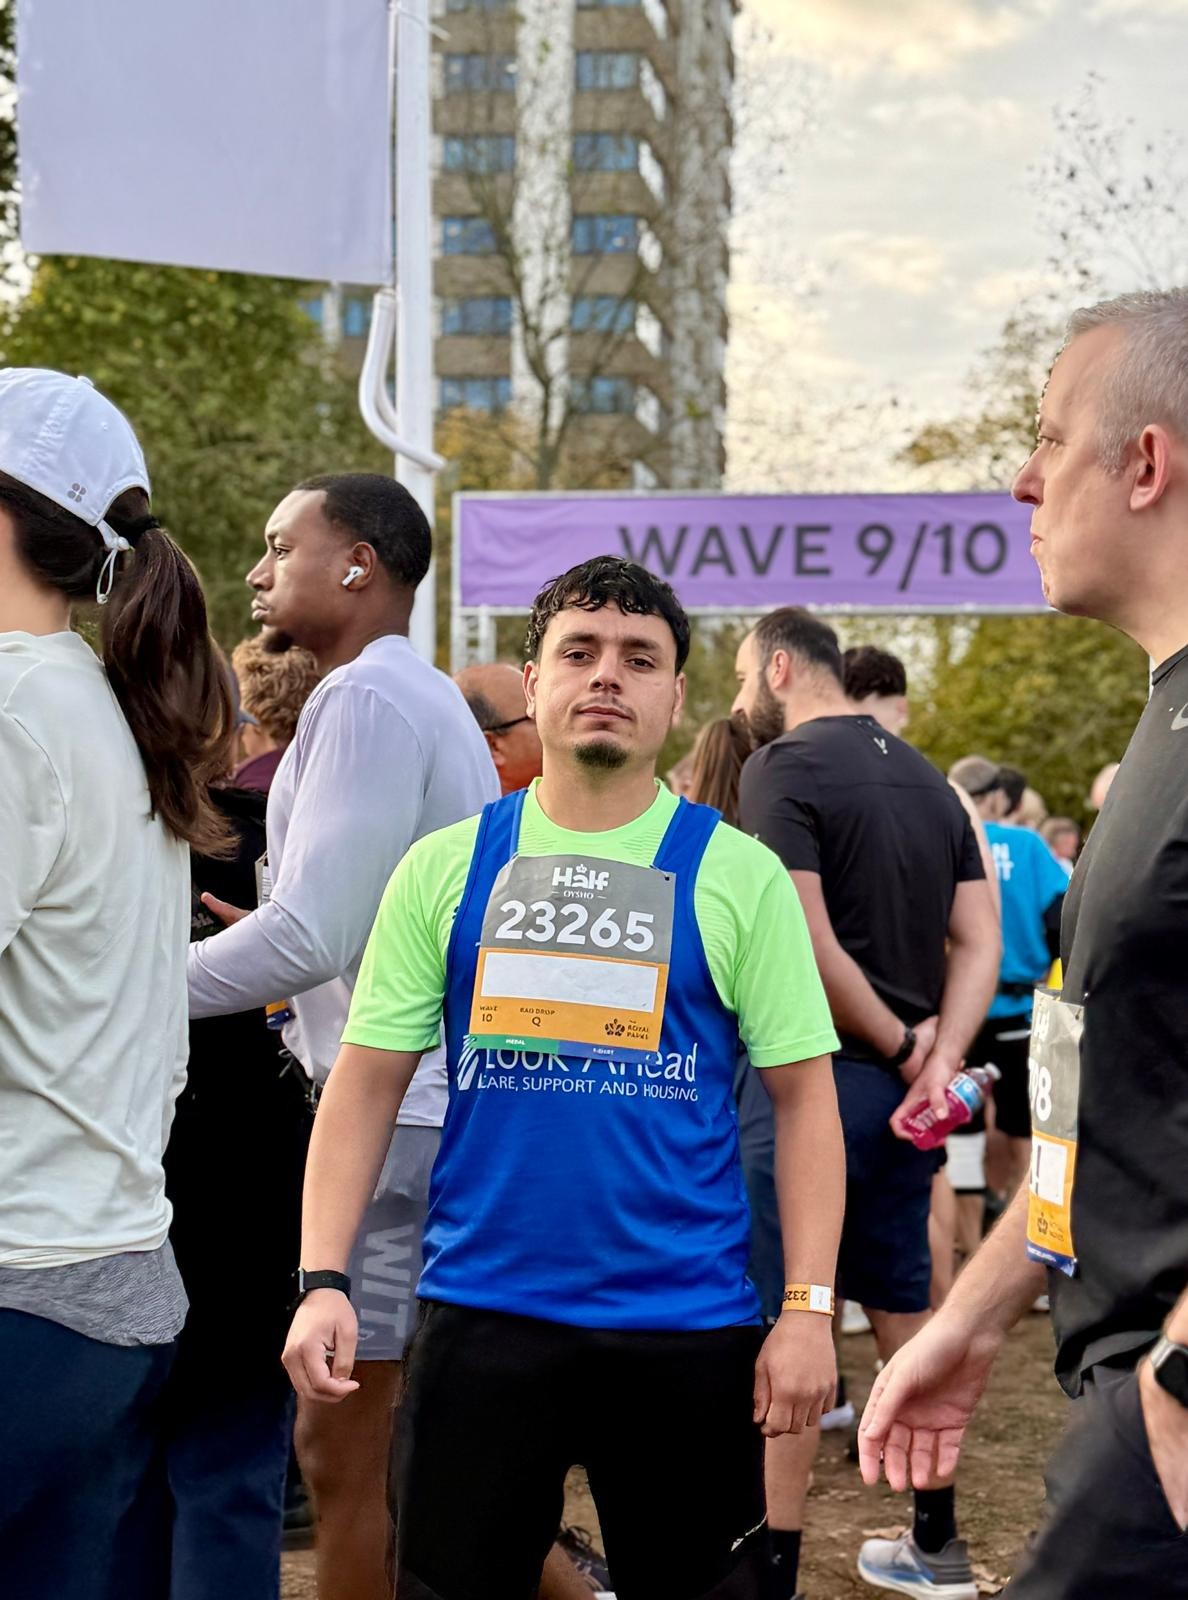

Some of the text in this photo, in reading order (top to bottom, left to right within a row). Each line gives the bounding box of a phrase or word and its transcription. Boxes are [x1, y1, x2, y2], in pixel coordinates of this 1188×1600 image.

[618, 521, 1008, 592] WAVE 9/10
[551, 866, 609, 891] Half
[495, 900, 654, 952] 23265
[482, 1013, 493, 1022] 10
[531, 1016, 541, 1027] Q
[522, 1076, 596, 1094] SUPPORT
[599, 1081, 638, 1096] AND
[643, 1083, 699, 1102] HOUSING
[361, 1224, 415, 1337] WIT
